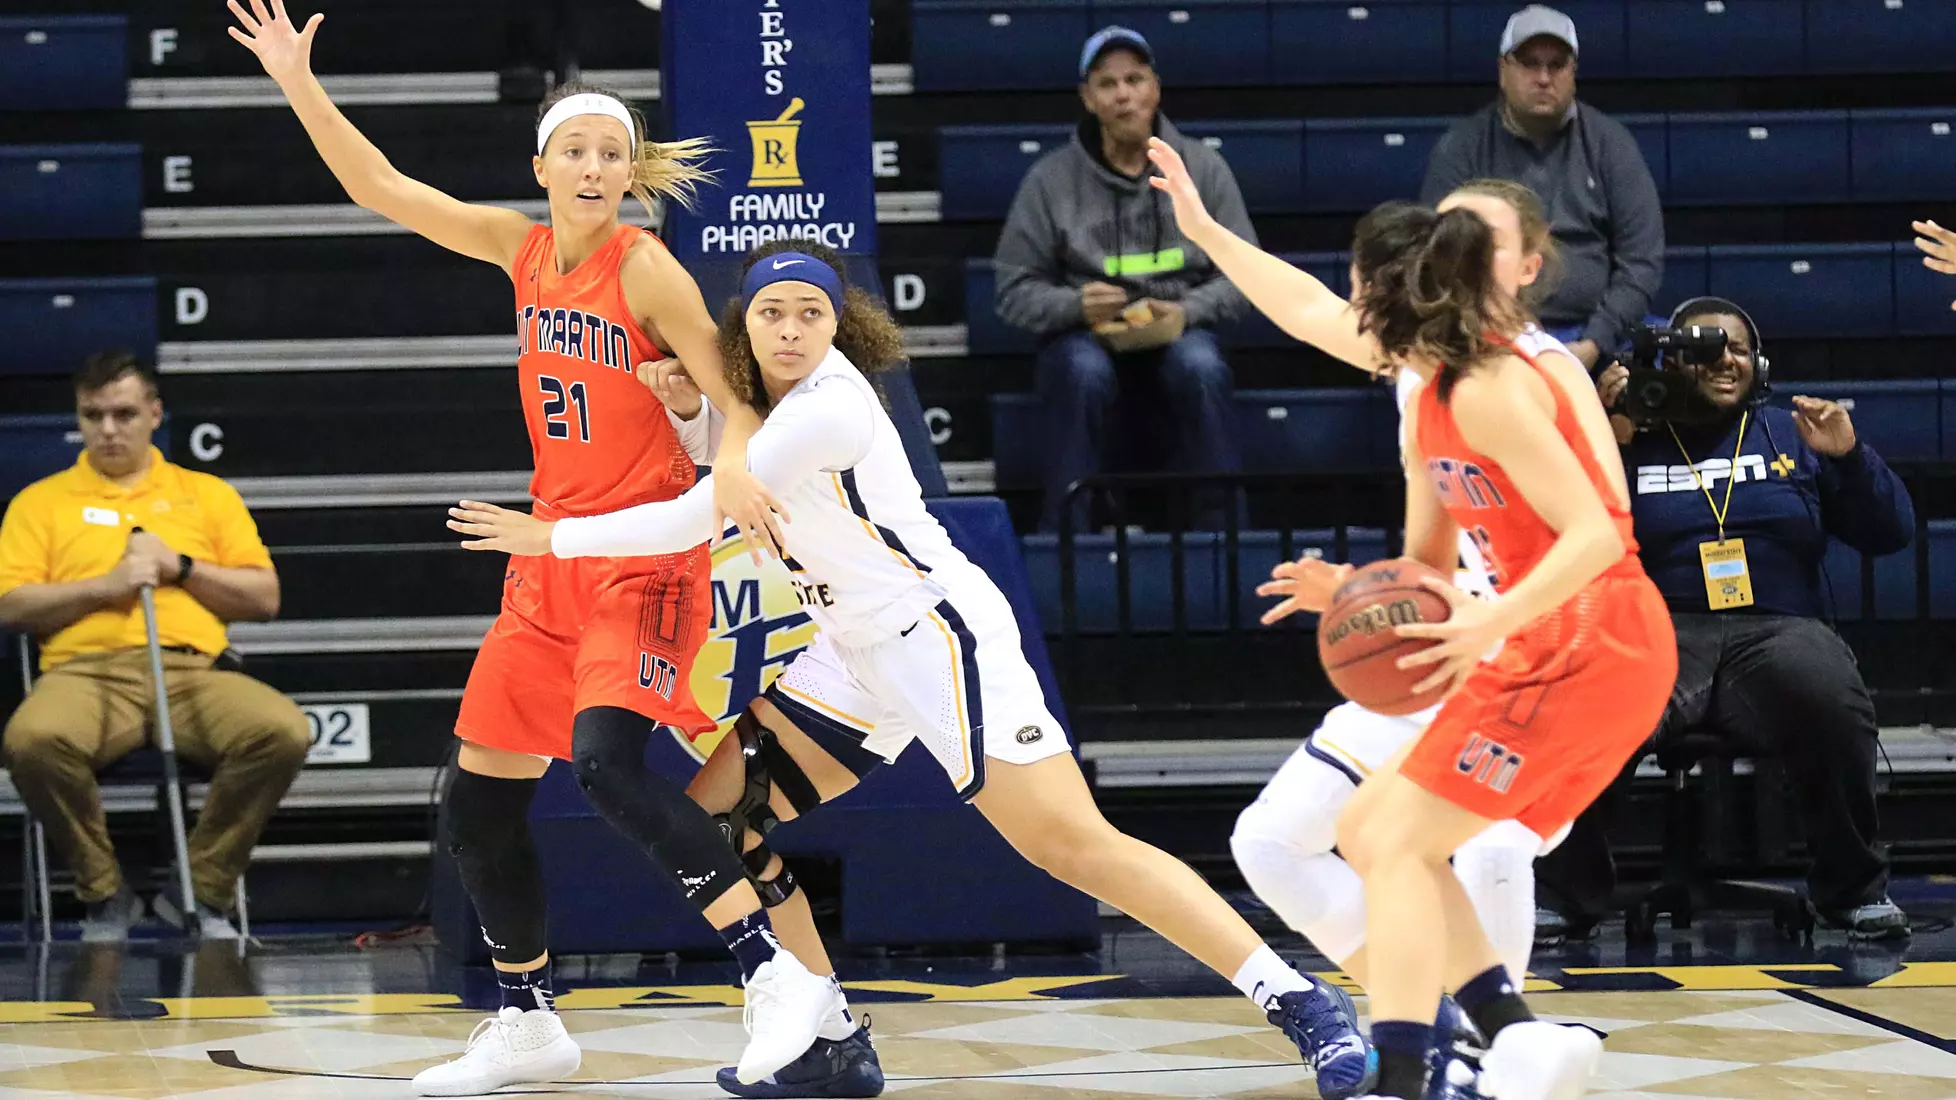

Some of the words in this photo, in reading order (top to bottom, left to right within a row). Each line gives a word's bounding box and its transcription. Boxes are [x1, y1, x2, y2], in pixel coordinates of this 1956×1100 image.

[150, 29, 178, 65] F
[164, 156, 194, 192] E
[871, 141, 900, 177] E
[729, 192, 825, 222] FAMILY
[702, 221, 855, 253] PHARMACY
[176, 287, 208, 324] D
[893, 274, 926, 311] D
[537, 307, 633, 374] MARTIN
[537, 373, 591, 444] 21
[923, 407, 952, 444] C
[189, 423, 223, 461] C
